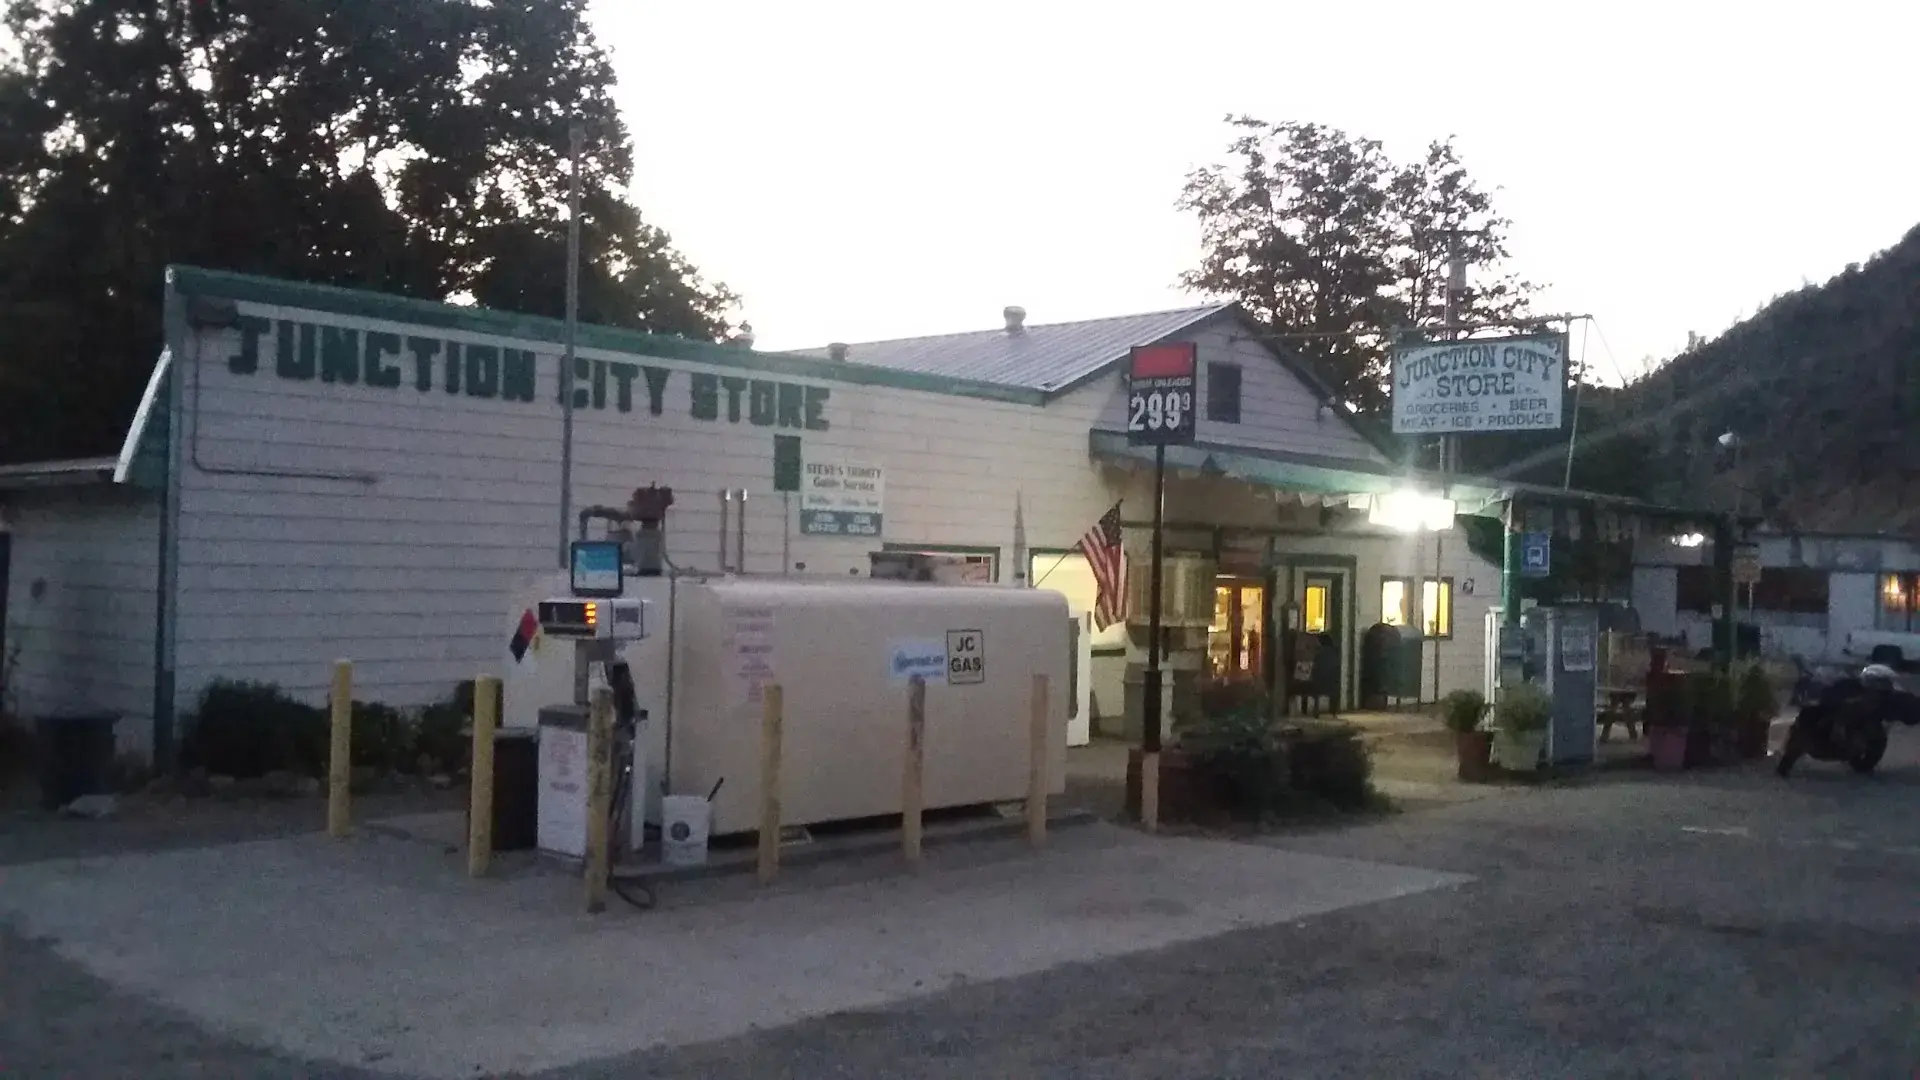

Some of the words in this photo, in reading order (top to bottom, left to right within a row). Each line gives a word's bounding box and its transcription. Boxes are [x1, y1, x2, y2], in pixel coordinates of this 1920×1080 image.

[228, 312, 536, 402] JUNCTION
[558, 355, 671, 416] CITY
[691, 371, 830, 431] STORE
[1400, 344, 1498, 388] JUNCTION
[1502, 346, 1557, 381] CITY
[1437, 371, 1515, 397] STORE
[1406, 401, 1480, 415] GROCERIES
[1509, 398, 1548, 411] BEER
[1400, 417, 1437, 429] MEAT
[1451, 416, 1473, 428] ICE
[1488, 413, 1554, 427] PRODUCE
[956, 636, 975, 652] JC
[951, 656, 982, 673] GAS
